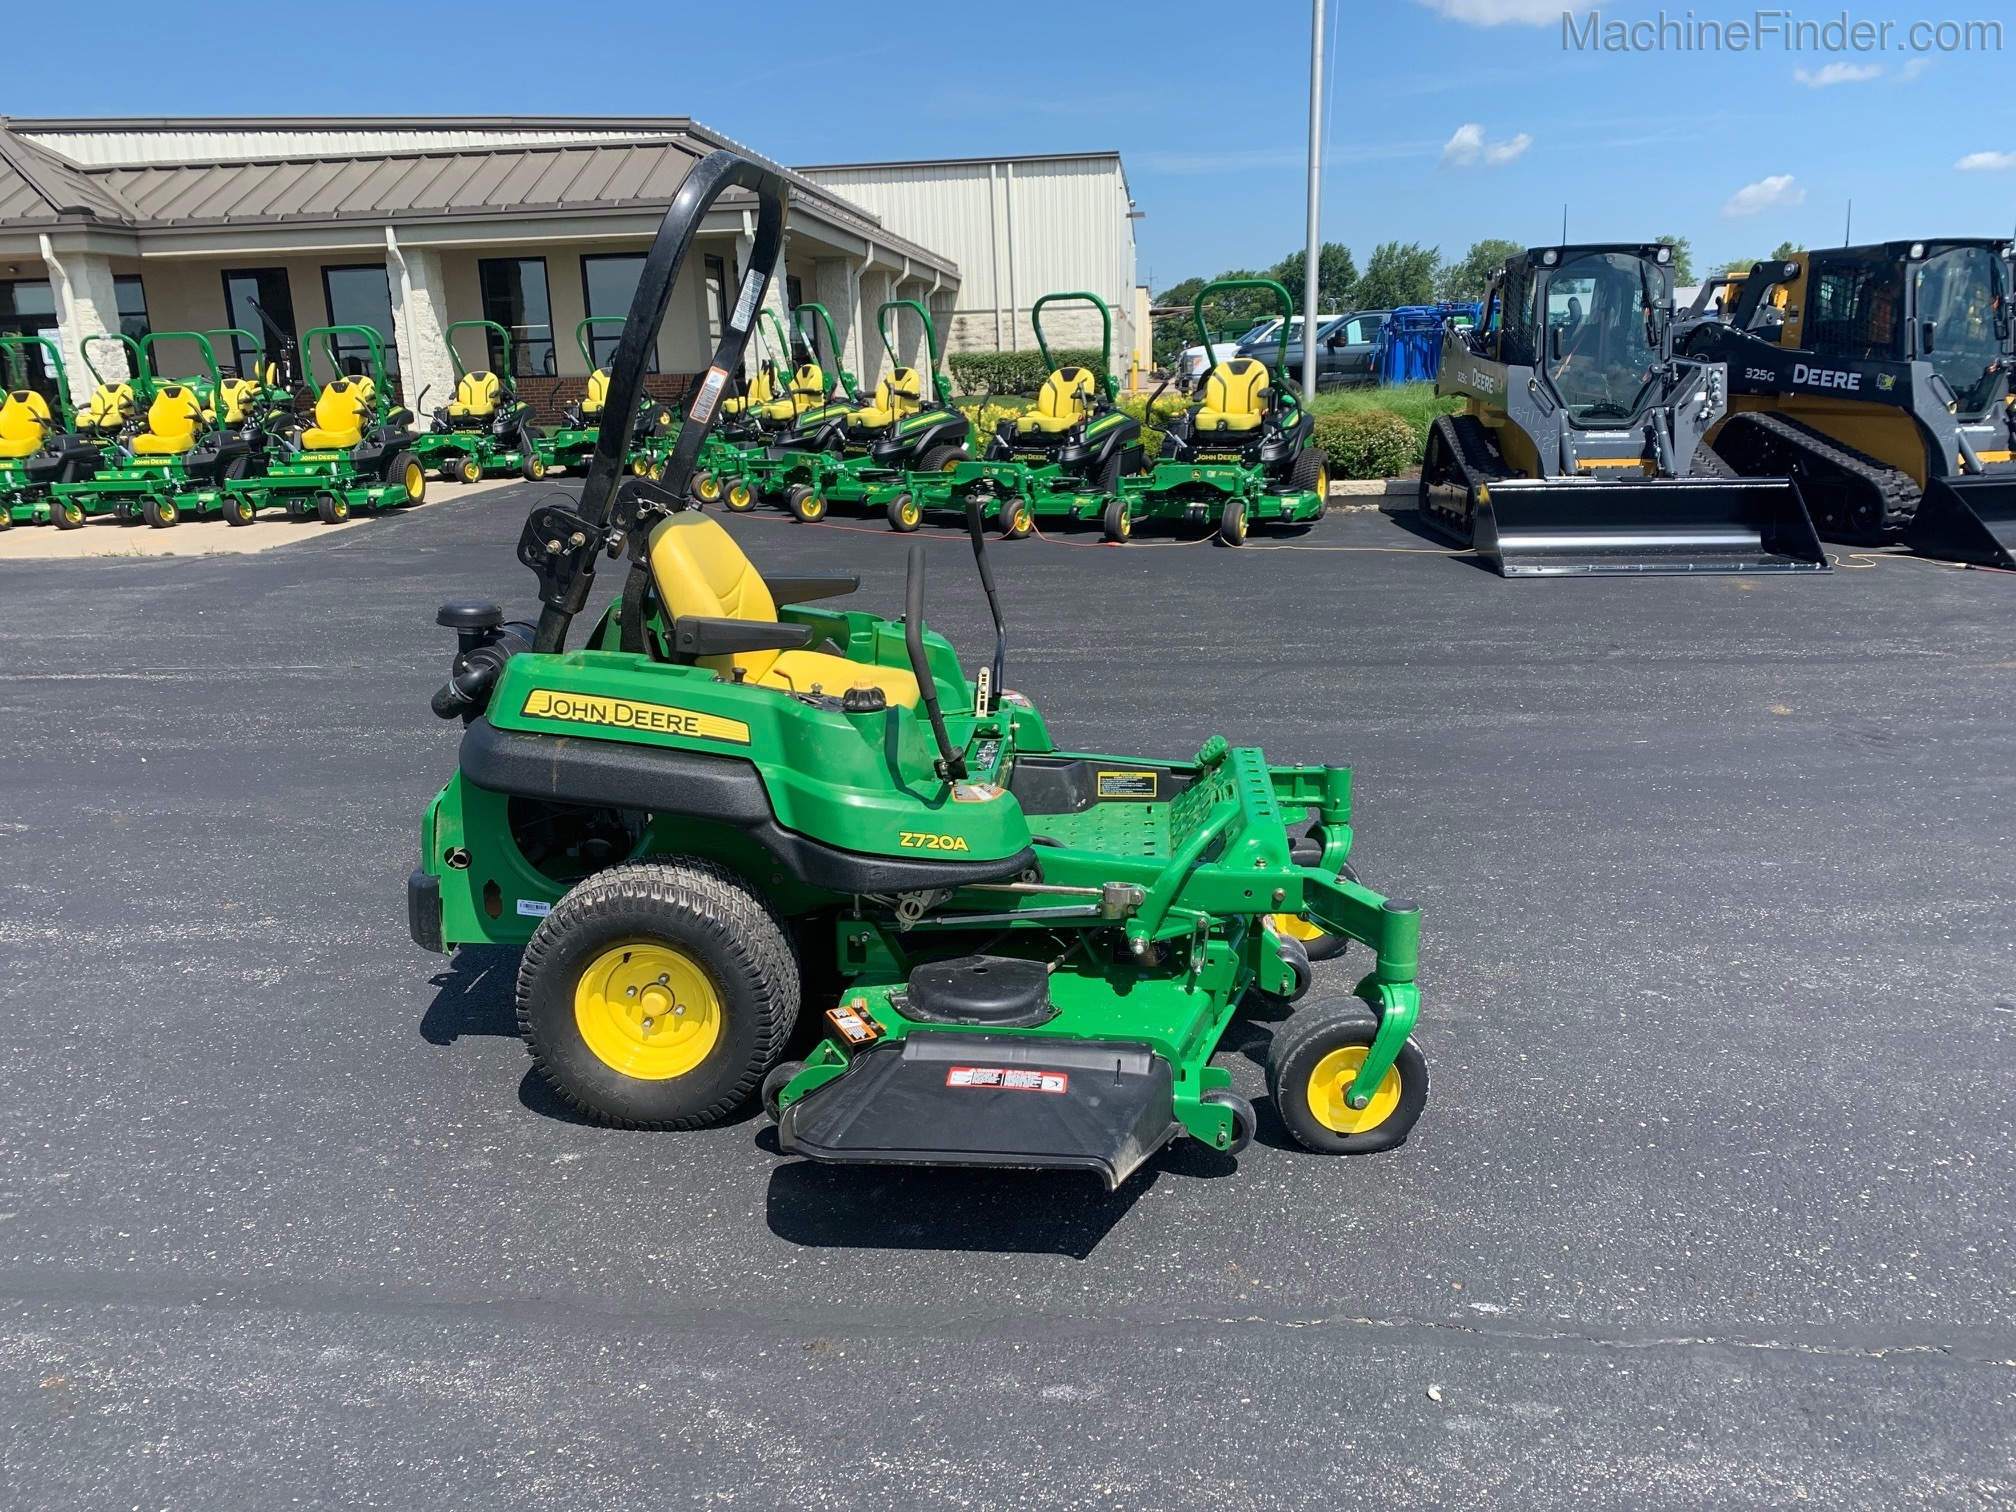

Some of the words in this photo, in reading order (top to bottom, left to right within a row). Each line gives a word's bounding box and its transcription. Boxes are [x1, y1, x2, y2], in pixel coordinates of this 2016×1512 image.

[1472, 367, 1495, 395] DEERE
[1744, 367, 1775, 382] 325G
[1792, 363, 1862, 391] DEERE
[150, 458, 172, 466] DEERE
[1196, 453, 1217, 461] JOHN
[1217, 453, 1243, 461] DEERE
[538, 694, 607, 721] JOHN
[613, 702, 699, 733] DEERE
[898, 831, 970, 852] Z720A
